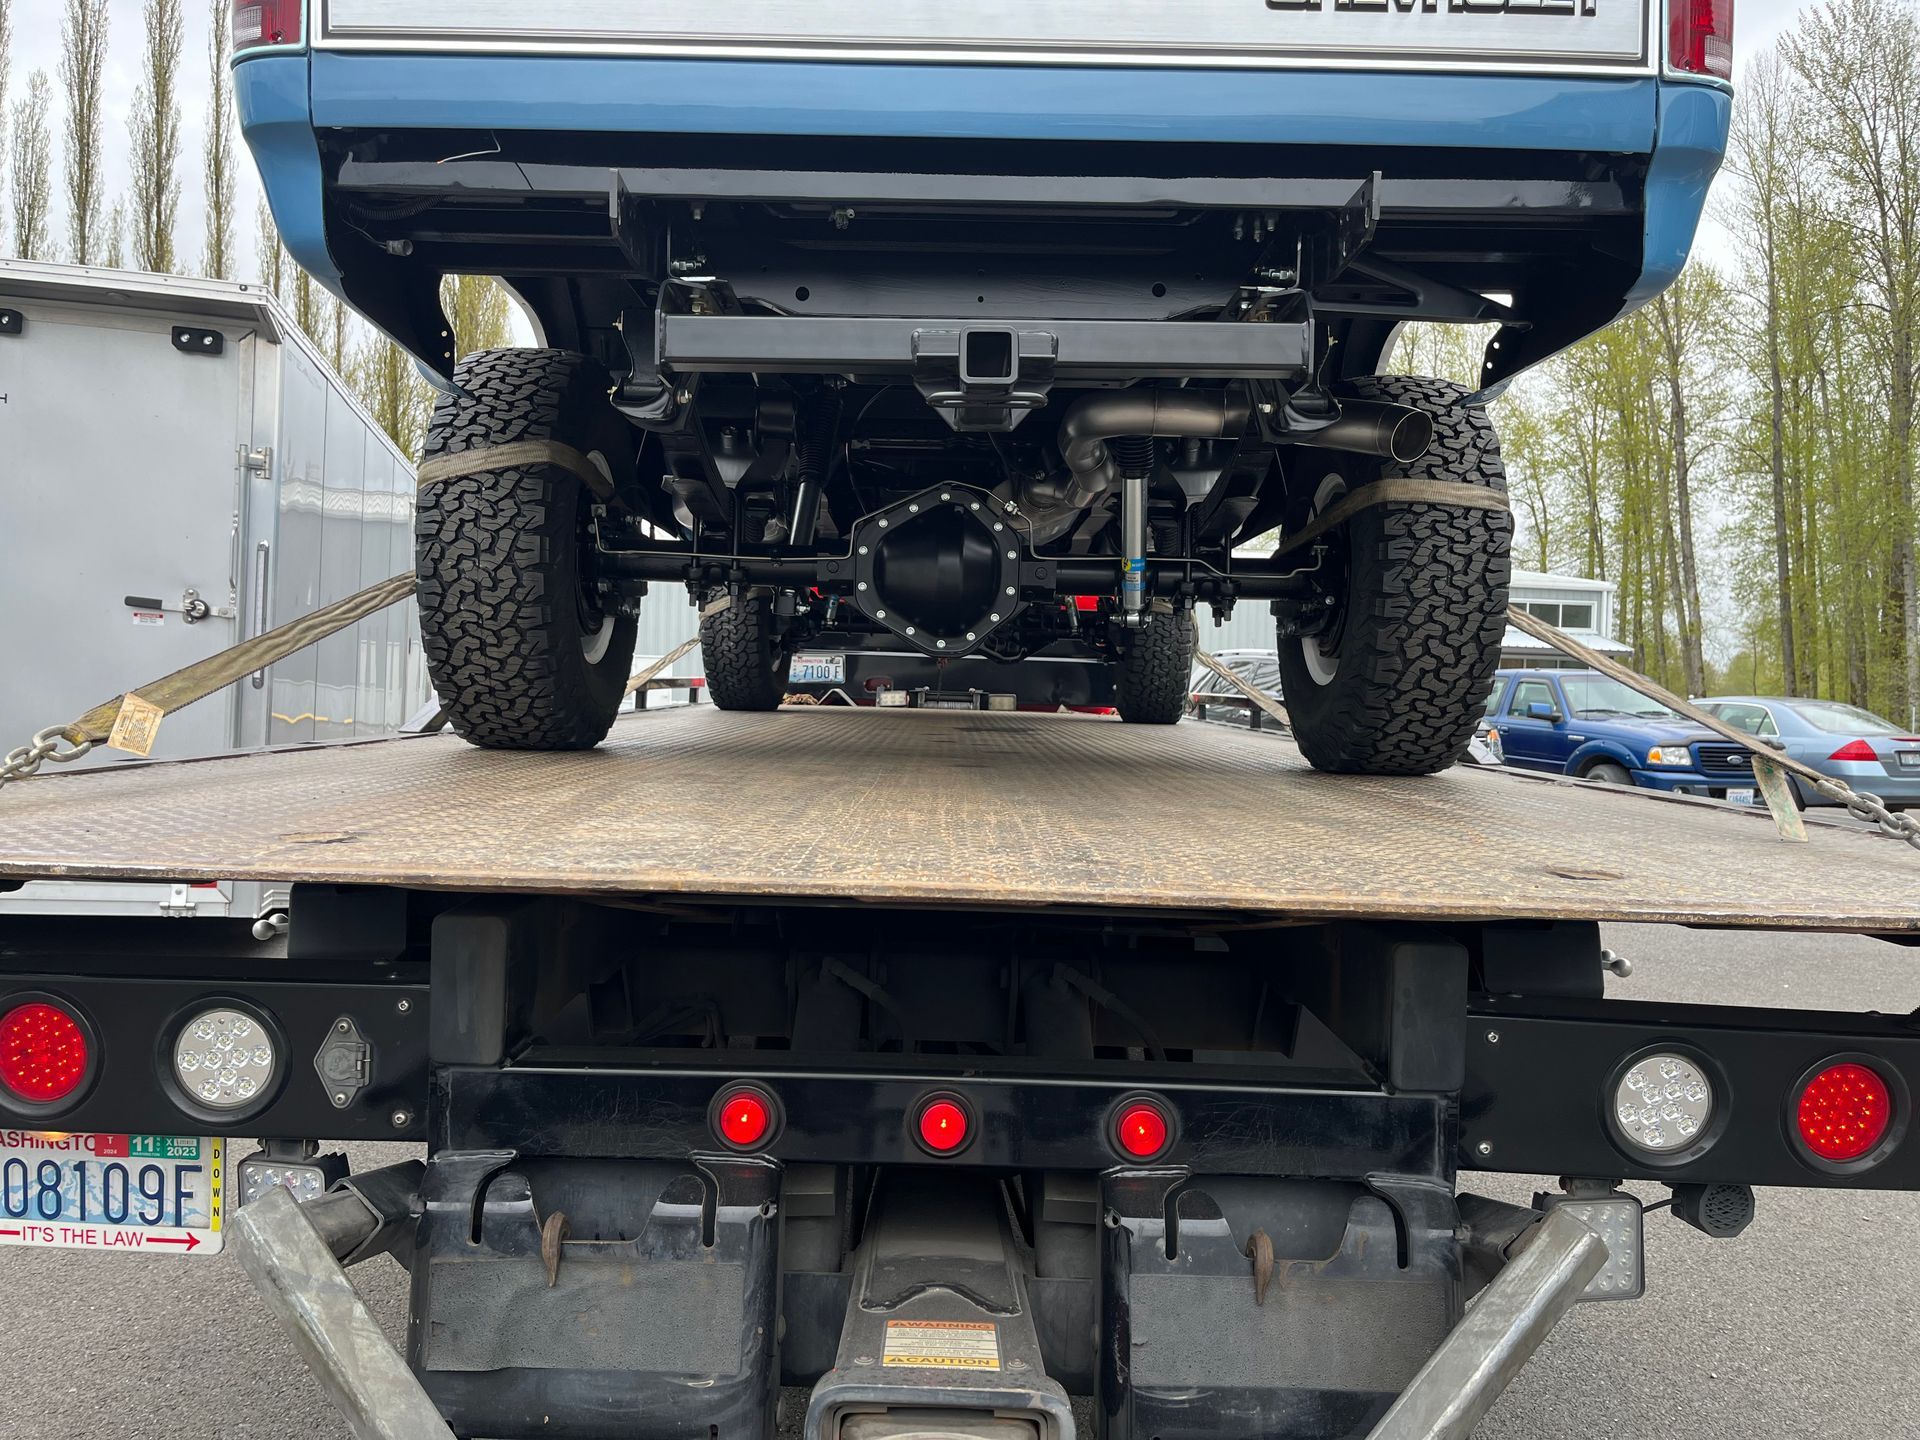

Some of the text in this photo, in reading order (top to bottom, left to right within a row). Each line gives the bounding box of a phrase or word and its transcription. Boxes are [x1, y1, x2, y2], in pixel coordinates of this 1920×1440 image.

[0, 1130, 96, 1151] ASHINGTO
[107, 1136, 114, 1145] T
[132, 1136, 154, 1153] 11
[166, 1146, 197, 1157] 2023
[3, 1157, 202, 1227] 08109F
[22, 1226, 143, 1247] IT'S THE LAW
[906, 1357, 990, 1365] CAUTION
